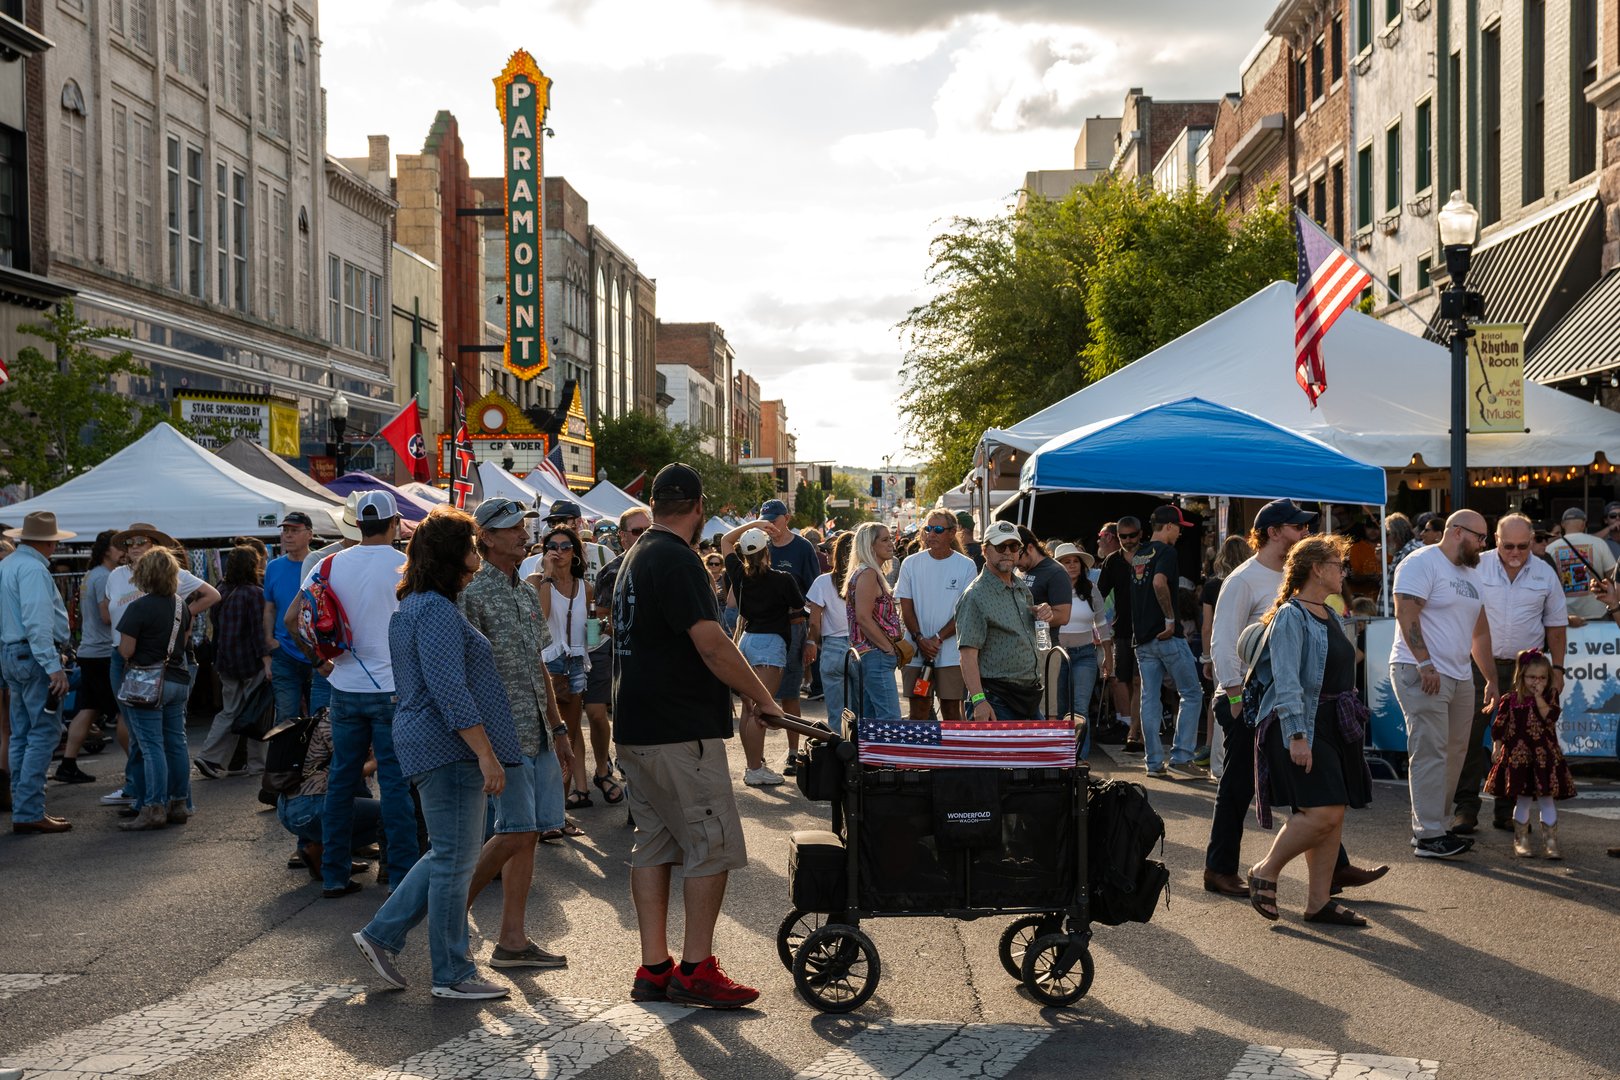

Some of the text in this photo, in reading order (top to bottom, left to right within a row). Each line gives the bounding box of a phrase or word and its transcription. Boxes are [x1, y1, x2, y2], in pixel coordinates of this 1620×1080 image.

[511, 83, 534, 360] PARAMOUNT
[1481, 332, 1503, 340] Bristol
[1481, 340, 1519, 356] Rhythm
[1489, 356, 1519, 367] Roots
[1509, 379, 1520, 387] All
[1496, 388, 1520, 397] About
[1506, 398, 1520, 406] The
[192, 403, 261, 416] STAGE SPONSORED BY
[1486, 408, 1521, 420] Music
[489, 441, 541, 450] CRWDER
[1565, 662, 1607, 680] cold
